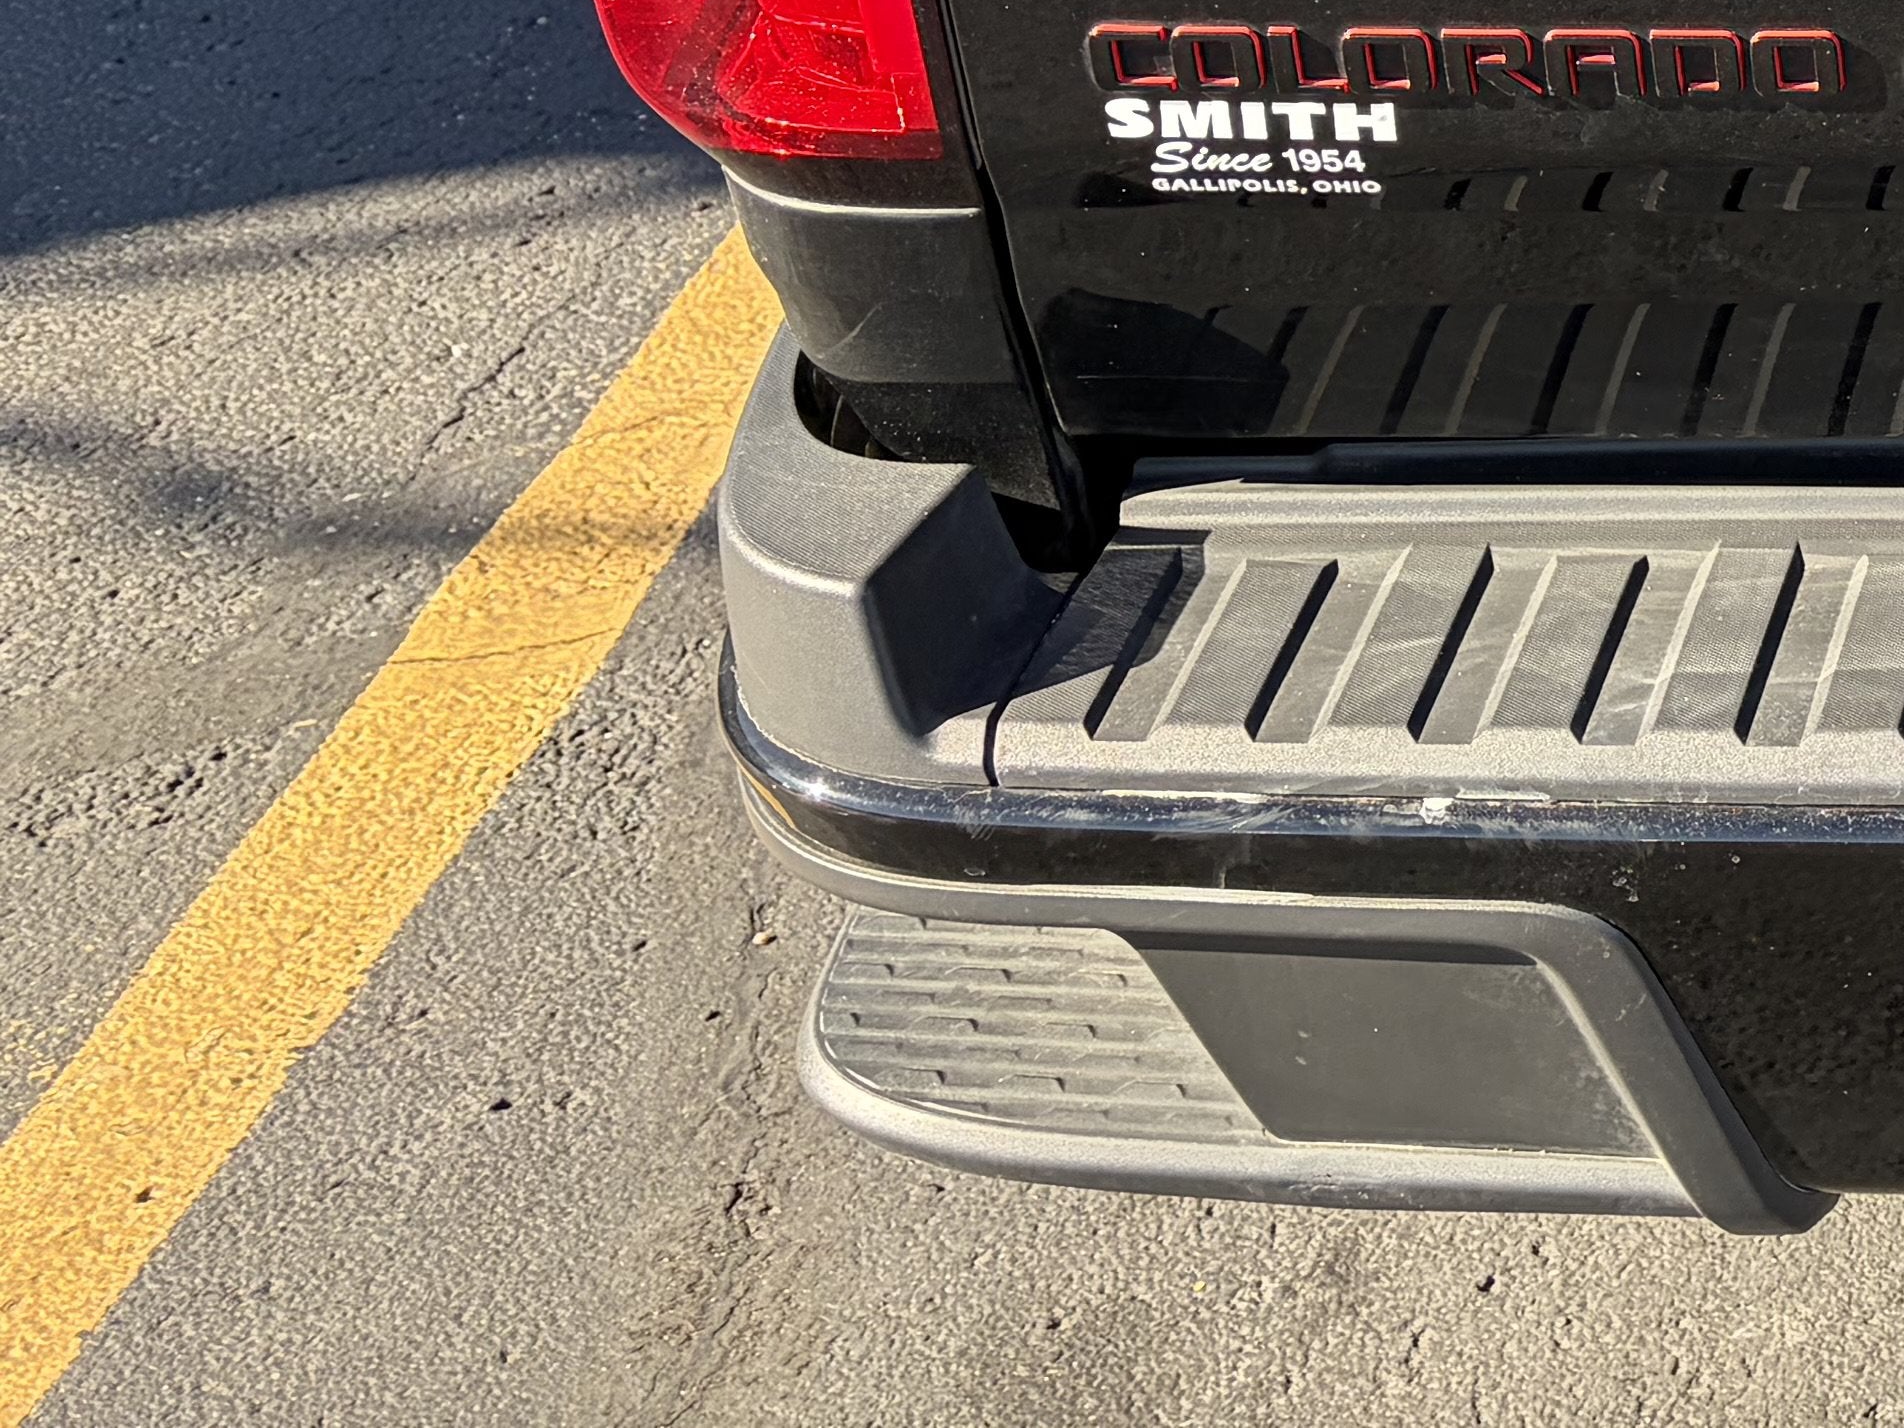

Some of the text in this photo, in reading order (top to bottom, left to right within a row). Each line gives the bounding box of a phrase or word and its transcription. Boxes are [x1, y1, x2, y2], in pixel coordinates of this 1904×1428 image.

[1085, 23, 1846, 98] COLORADO
[1104, 97, 1397, 142] SMITH
[1150, 141, 1366, 173] Since 1954
[1152, 177, 1382, 195] GALLIPOLIS, OHIO
